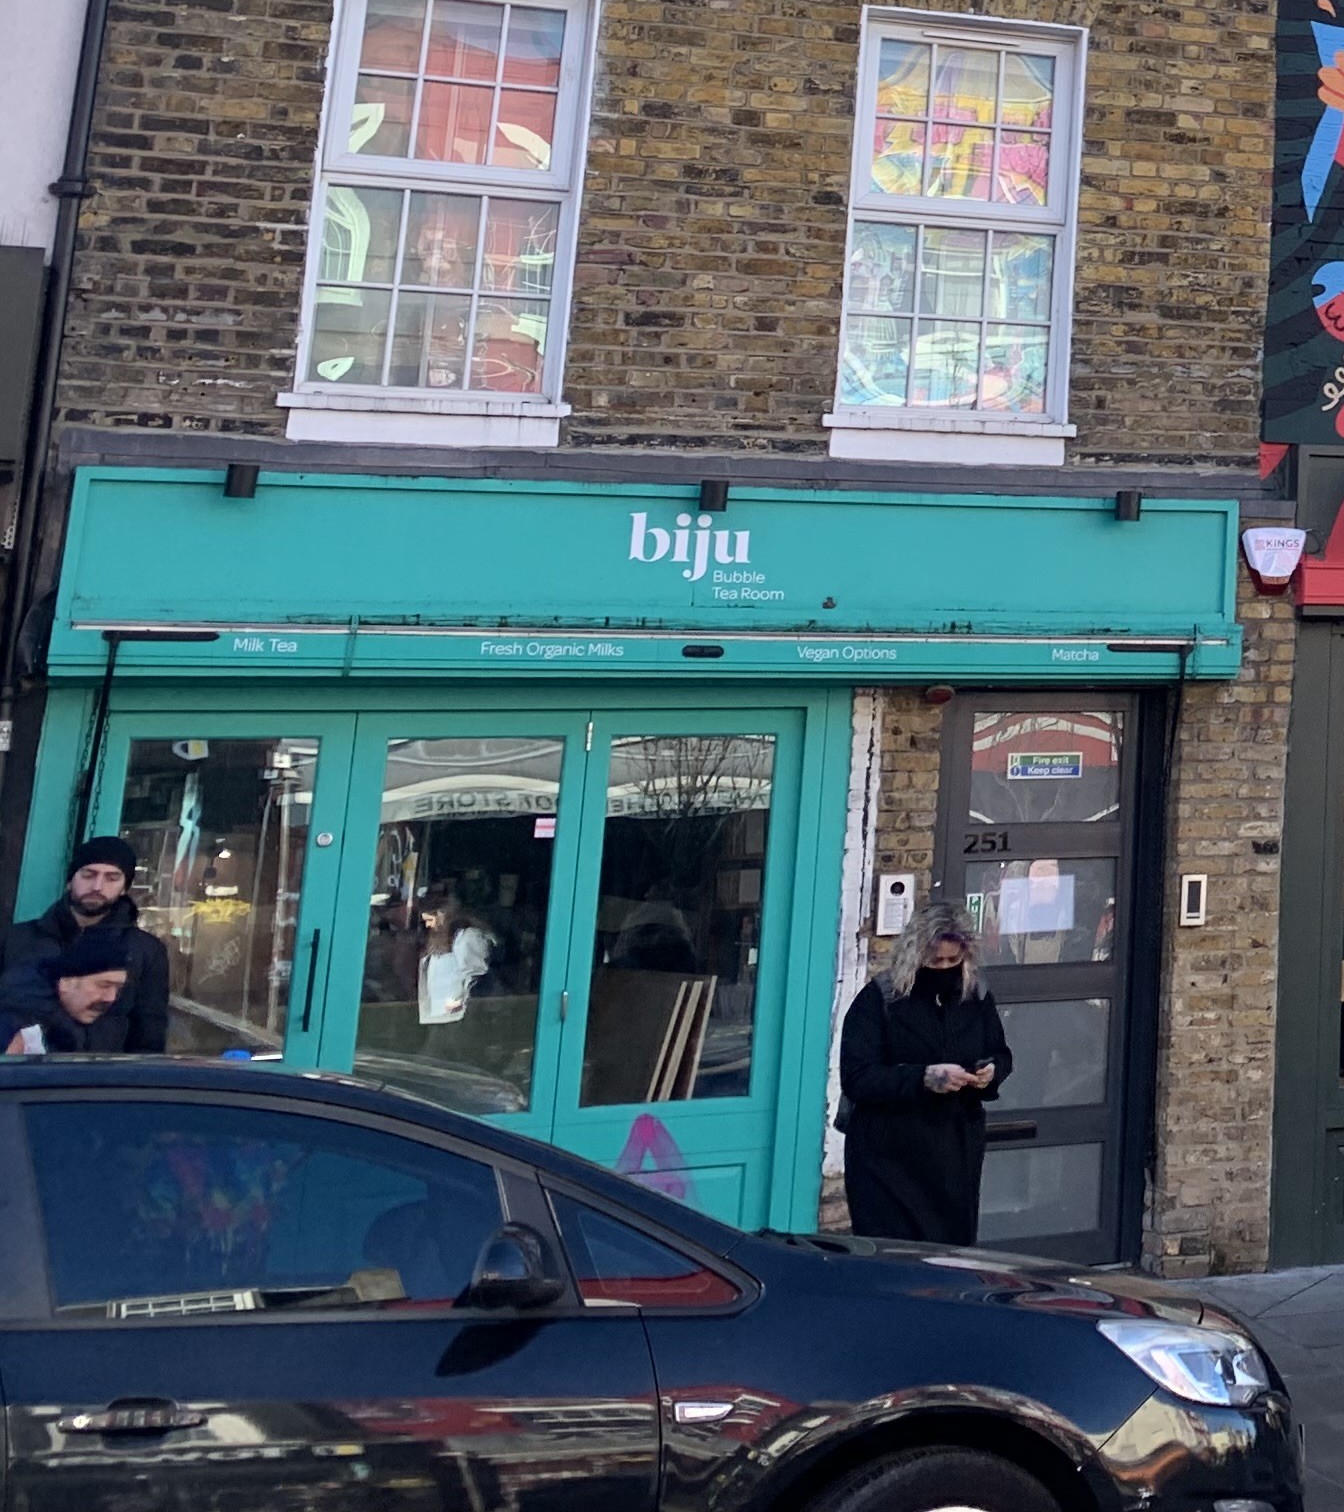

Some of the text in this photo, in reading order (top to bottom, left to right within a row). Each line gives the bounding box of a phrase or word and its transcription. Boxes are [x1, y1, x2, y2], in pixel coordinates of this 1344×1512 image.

[628, 512, 751, 582] biju
[1266, 539, 1300, 548] KINGS
[713, 569, 765, 583] Bubble
[712, 586, 785, 600] Tea Room
[233, 637, 298, 653] Milk Tea
[480, 641, 624, 660] Fresh Organic Milks
[797, 645, 897, 662] Vegan Options
[1051, 647, 1100, 662] Matcha
[1032, 756, 1069, 766] Fire exit
[1027, 767, 1051, 776] Keep
[963, 832, 1011, 854] 251
